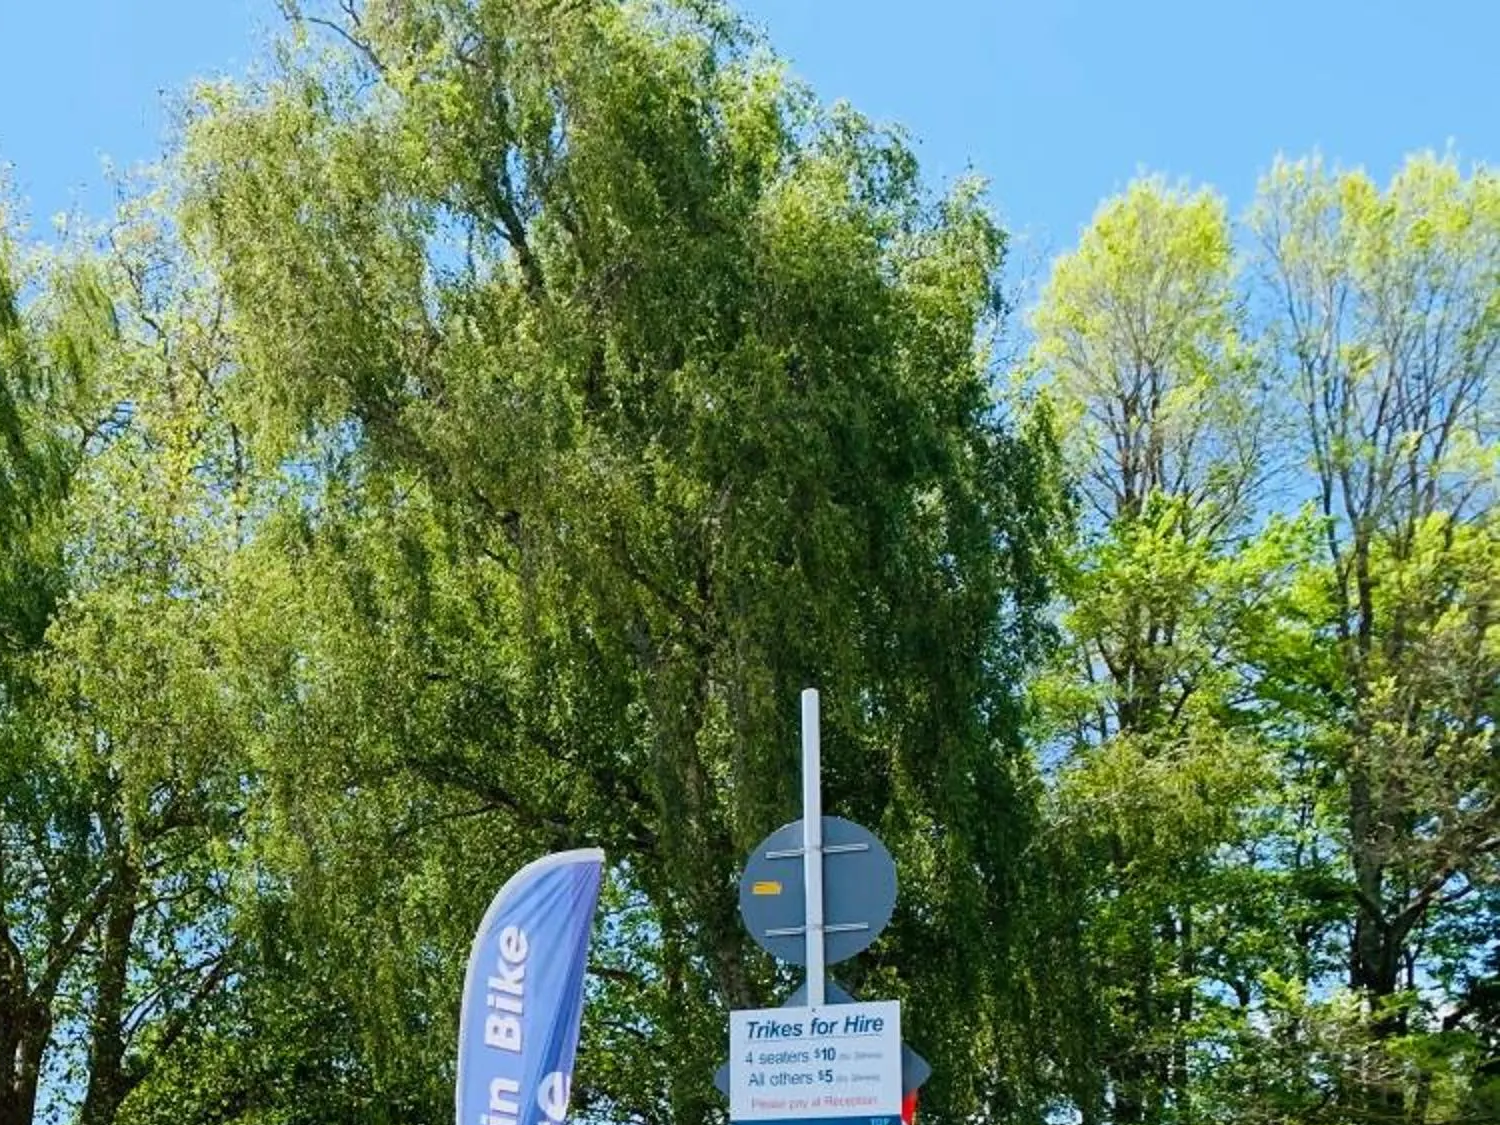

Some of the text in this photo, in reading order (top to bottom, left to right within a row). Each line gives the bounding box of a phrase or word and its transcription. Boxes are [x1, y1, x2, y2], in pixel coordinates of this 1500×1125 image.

[484, 925, 529, 1053] Bike
[747, 1014, 885, 1039] Trikes for Hire
[745, 1051, 753, 1064] 4
[758, 1051, 809, 1065] seaters
[814, 1047, 837, 1061] $10
[748, 1071, 765, 1086] All
[769, 1071, 813, 1087] others
[817, 1069, 833, 1083] $5
